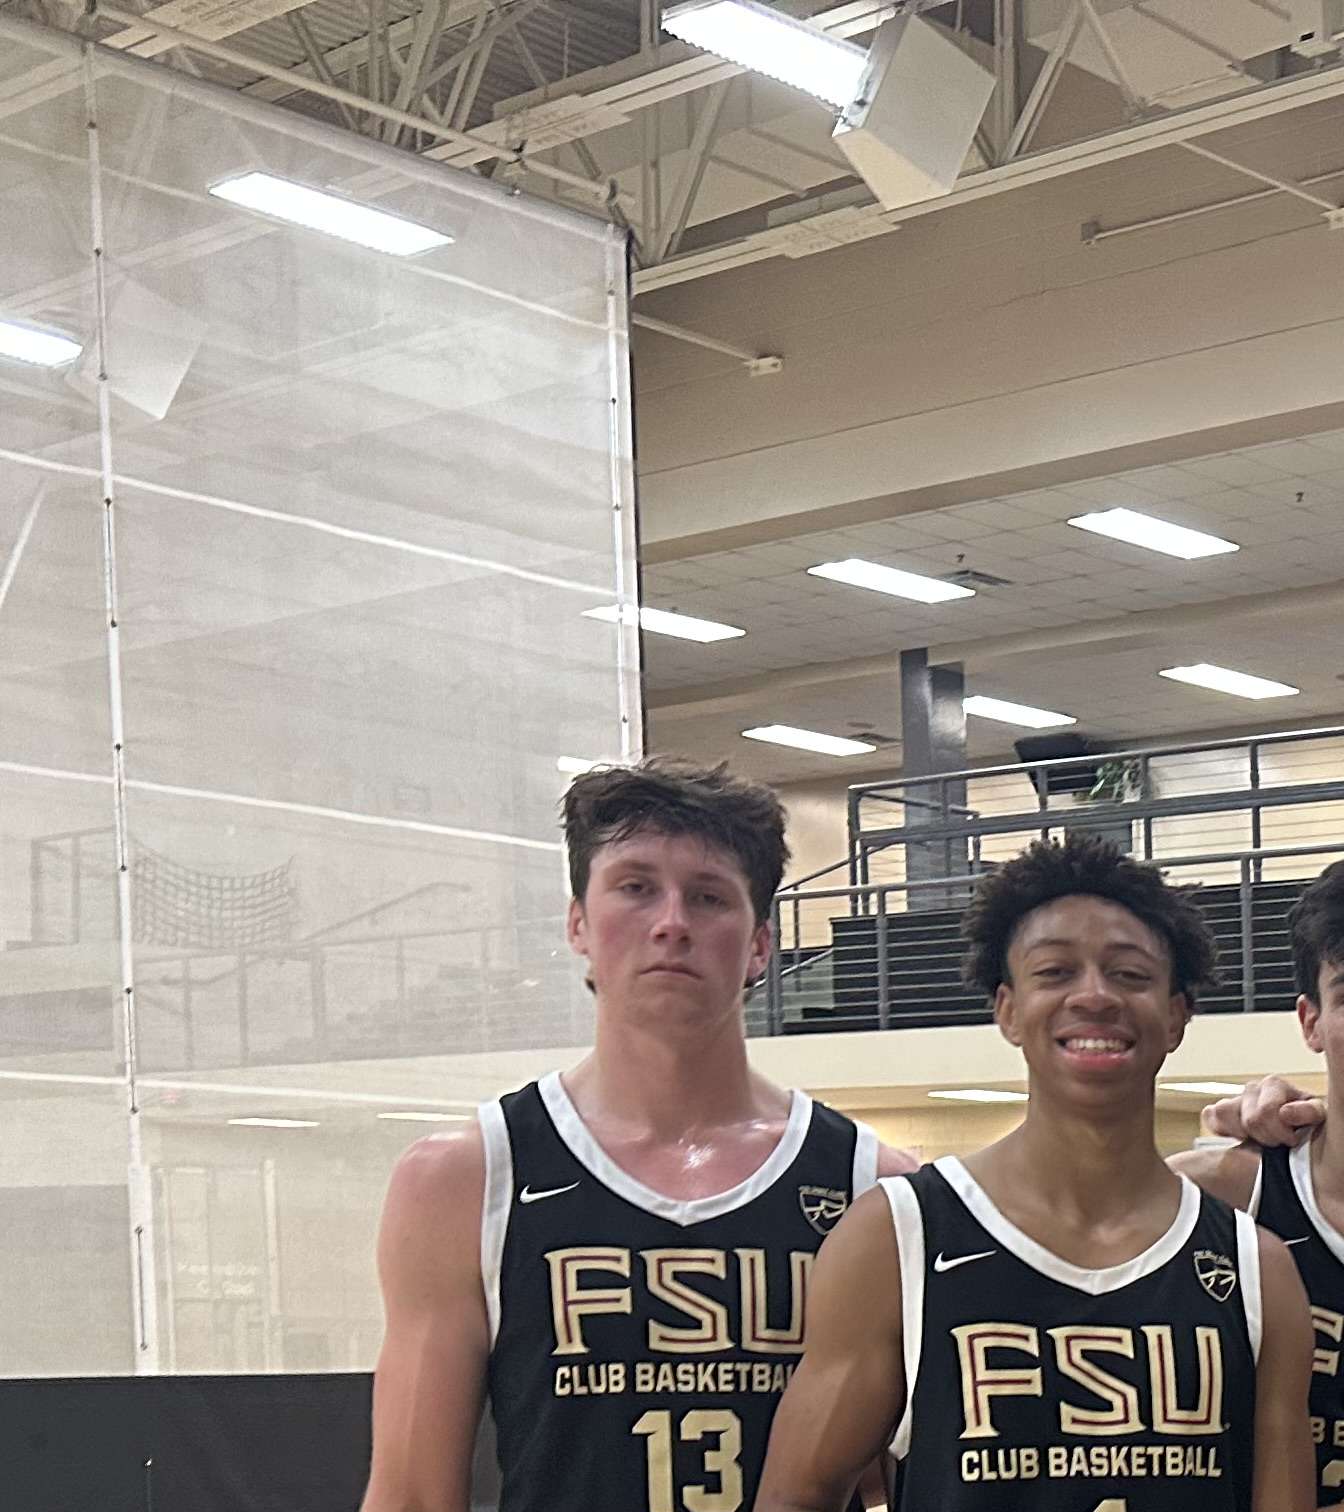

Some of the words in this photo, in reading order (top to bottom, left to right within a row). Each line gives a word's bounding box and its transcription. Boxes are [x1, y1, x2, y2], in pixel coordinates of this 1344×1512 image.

[544, 1246, 816, 1355] FSU
[555, 1363, 625, 1396] CLUB
[951, 1322, 1226, 1440] FSU
[961, 1448, 1040, 1482] CLUB
[1048, 1445, 1223, 1478] BASKETBALL
